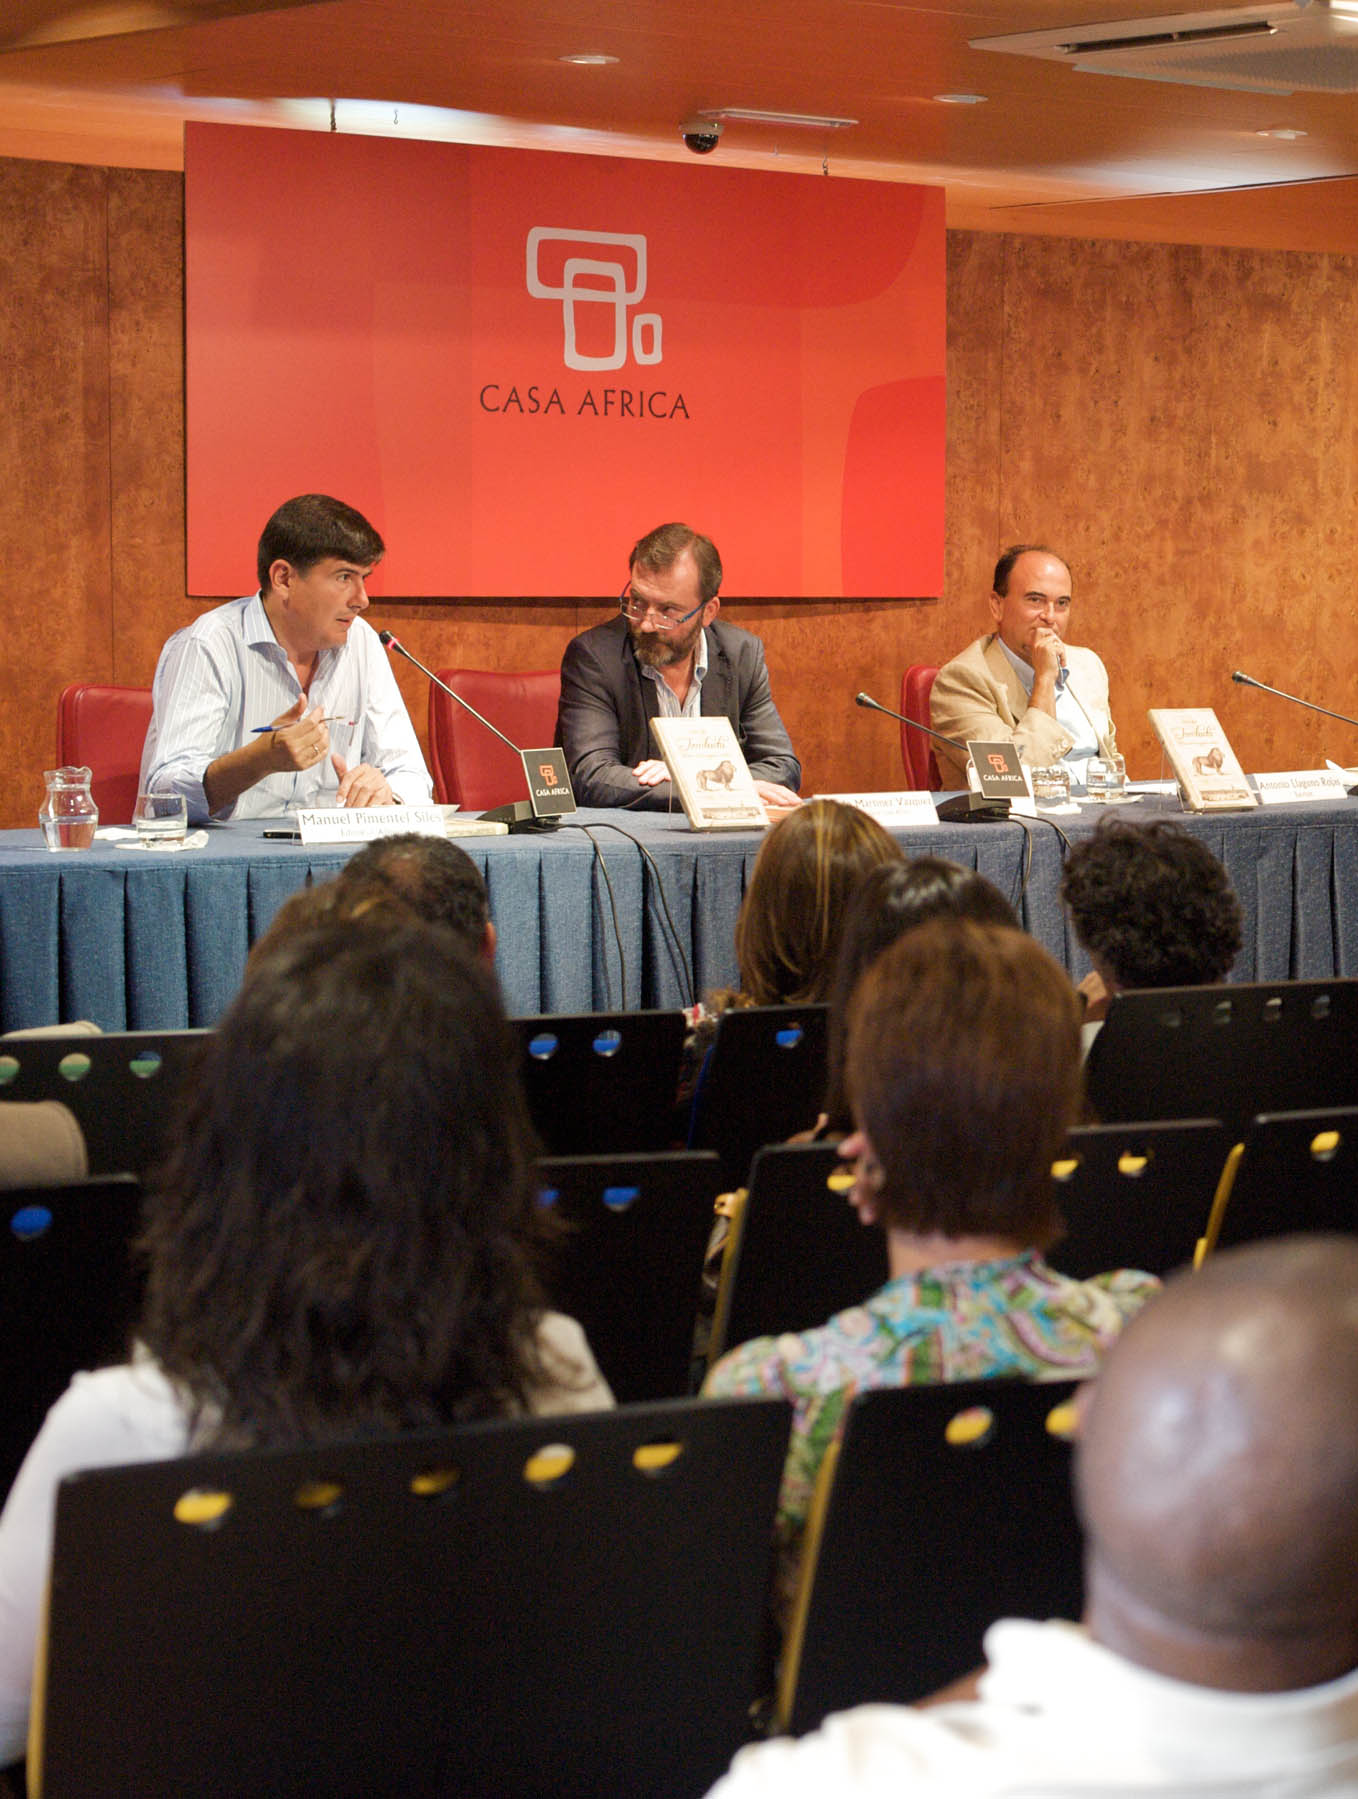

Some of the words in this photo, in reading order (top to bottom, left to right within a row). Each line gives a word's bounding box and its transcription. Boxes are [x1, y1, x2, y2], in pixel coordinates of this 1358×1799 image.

[479, 384, 566, 415] CASA
[577, 389, 690, 420] AFRICA
[1001, 774, 1023, 782] AFRICA
[536, 788, 551, 797] CASA
[551, 787, 570, 796] AFRICA
[302, 813, 351, 826] Manuel
[356, 811, 410, 825] Pimentel
[414, 811, 442, 824] Siles
